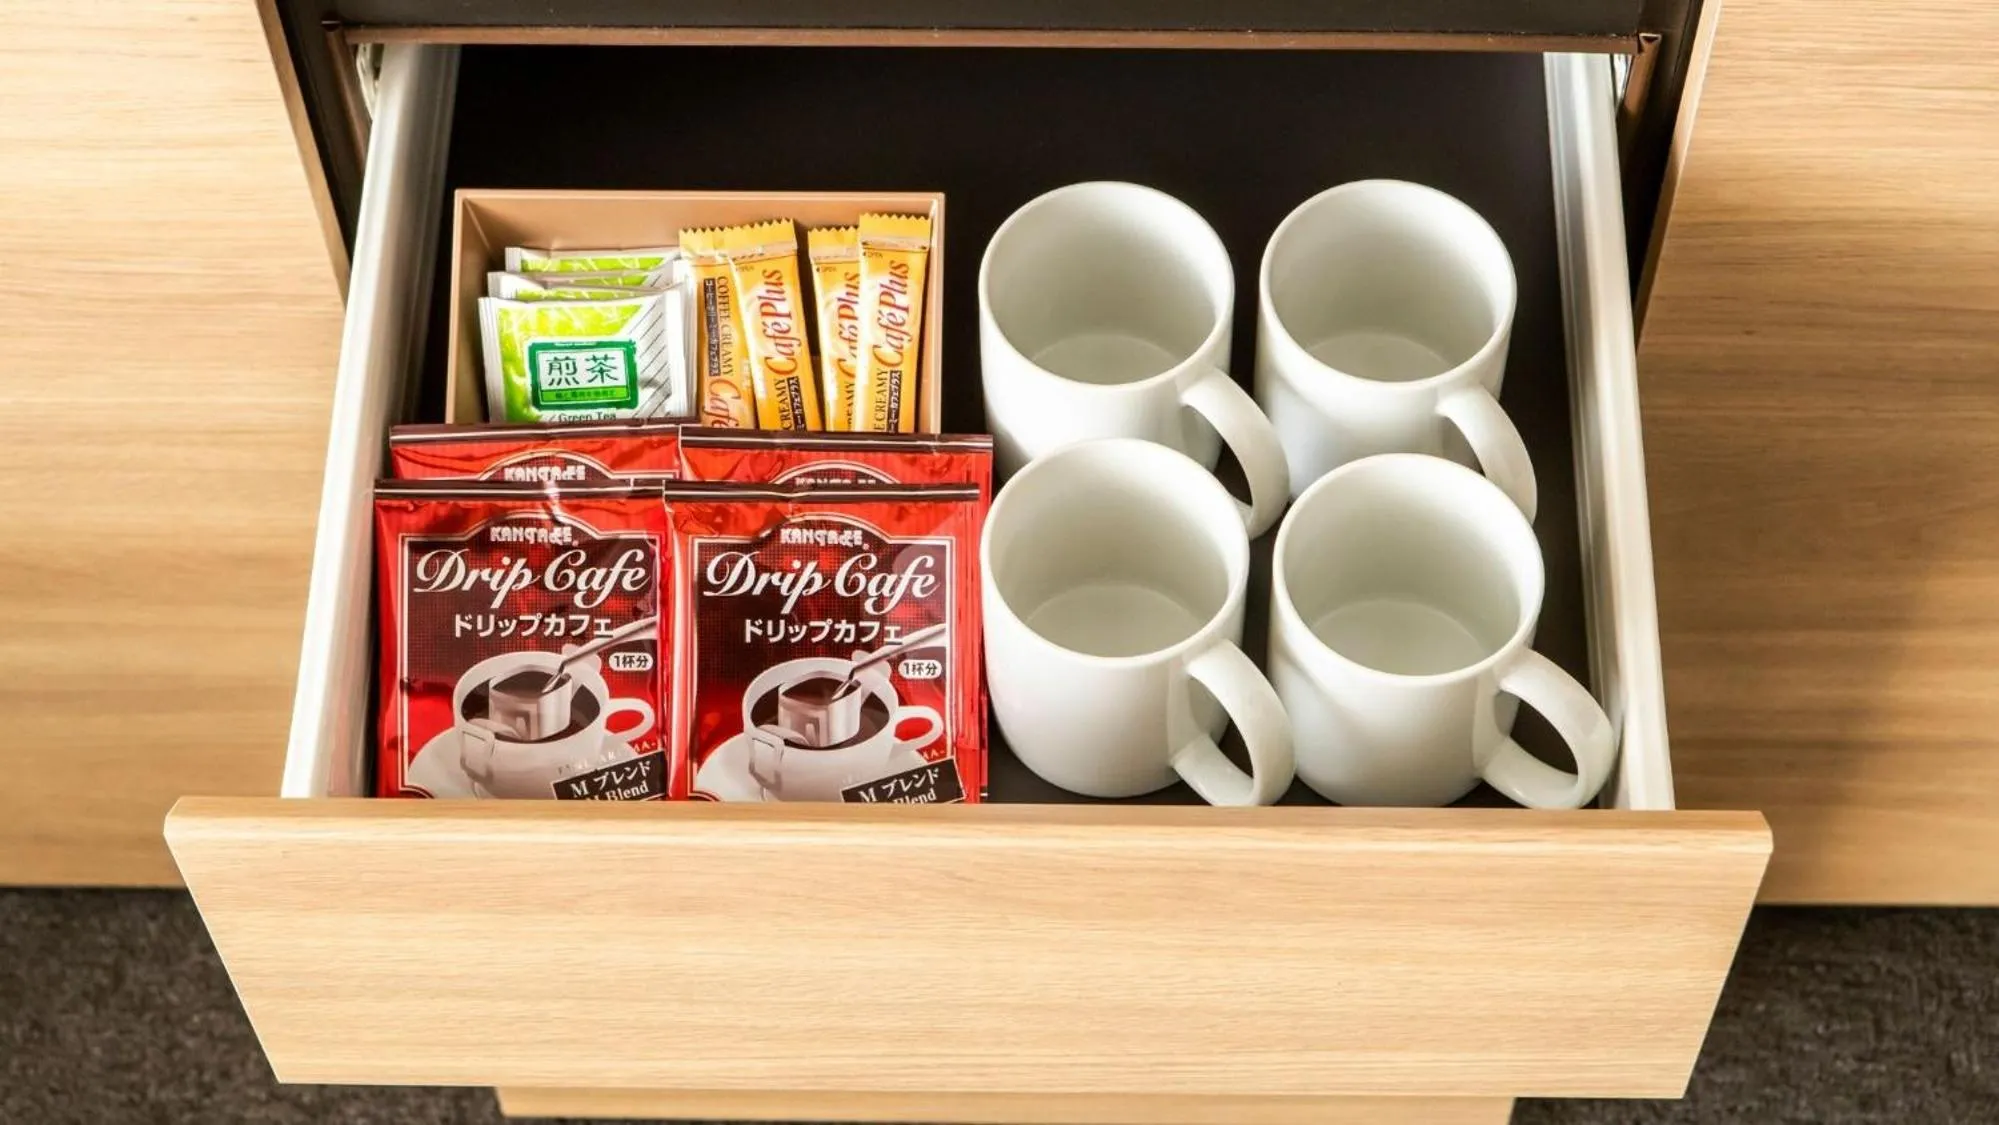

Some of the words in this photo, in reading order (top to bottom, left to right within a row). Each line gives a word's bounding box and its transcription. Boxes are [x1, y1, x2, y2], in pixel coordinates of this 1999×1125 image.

[717, 276, 731, 322] COFFEE
[721, 323, 734, 376] CREAMY
[546, 353, 619, 386] 煎茶
[774, 377, 793, 430] CREAMY
[875, 369, 889, 415] CREAMY
[559, 412, 592, 425] Green
[595, 410, 617, 421] Tea
[413, 549, 541, 608] Drip
[544, 549, 650, 608] Cafe
[703, 551, 830, 614] Drip
[834, 552, 939, 615] Cafe
[455, 612, 613, 638] ドリップカフェ
[745, 618, 902, 644] ドリップカフェ
[613, 655, 648, 668] 1杯分
[903, 662, 938, 676] 1杯分
[570, 780, 589, 798] M
[593, 761, 651, 791] ブレンド
[605, 780, 649, 800] Blend
[859, 787, 878, 802] M
[881, 768, 939, 798] ブレンド
